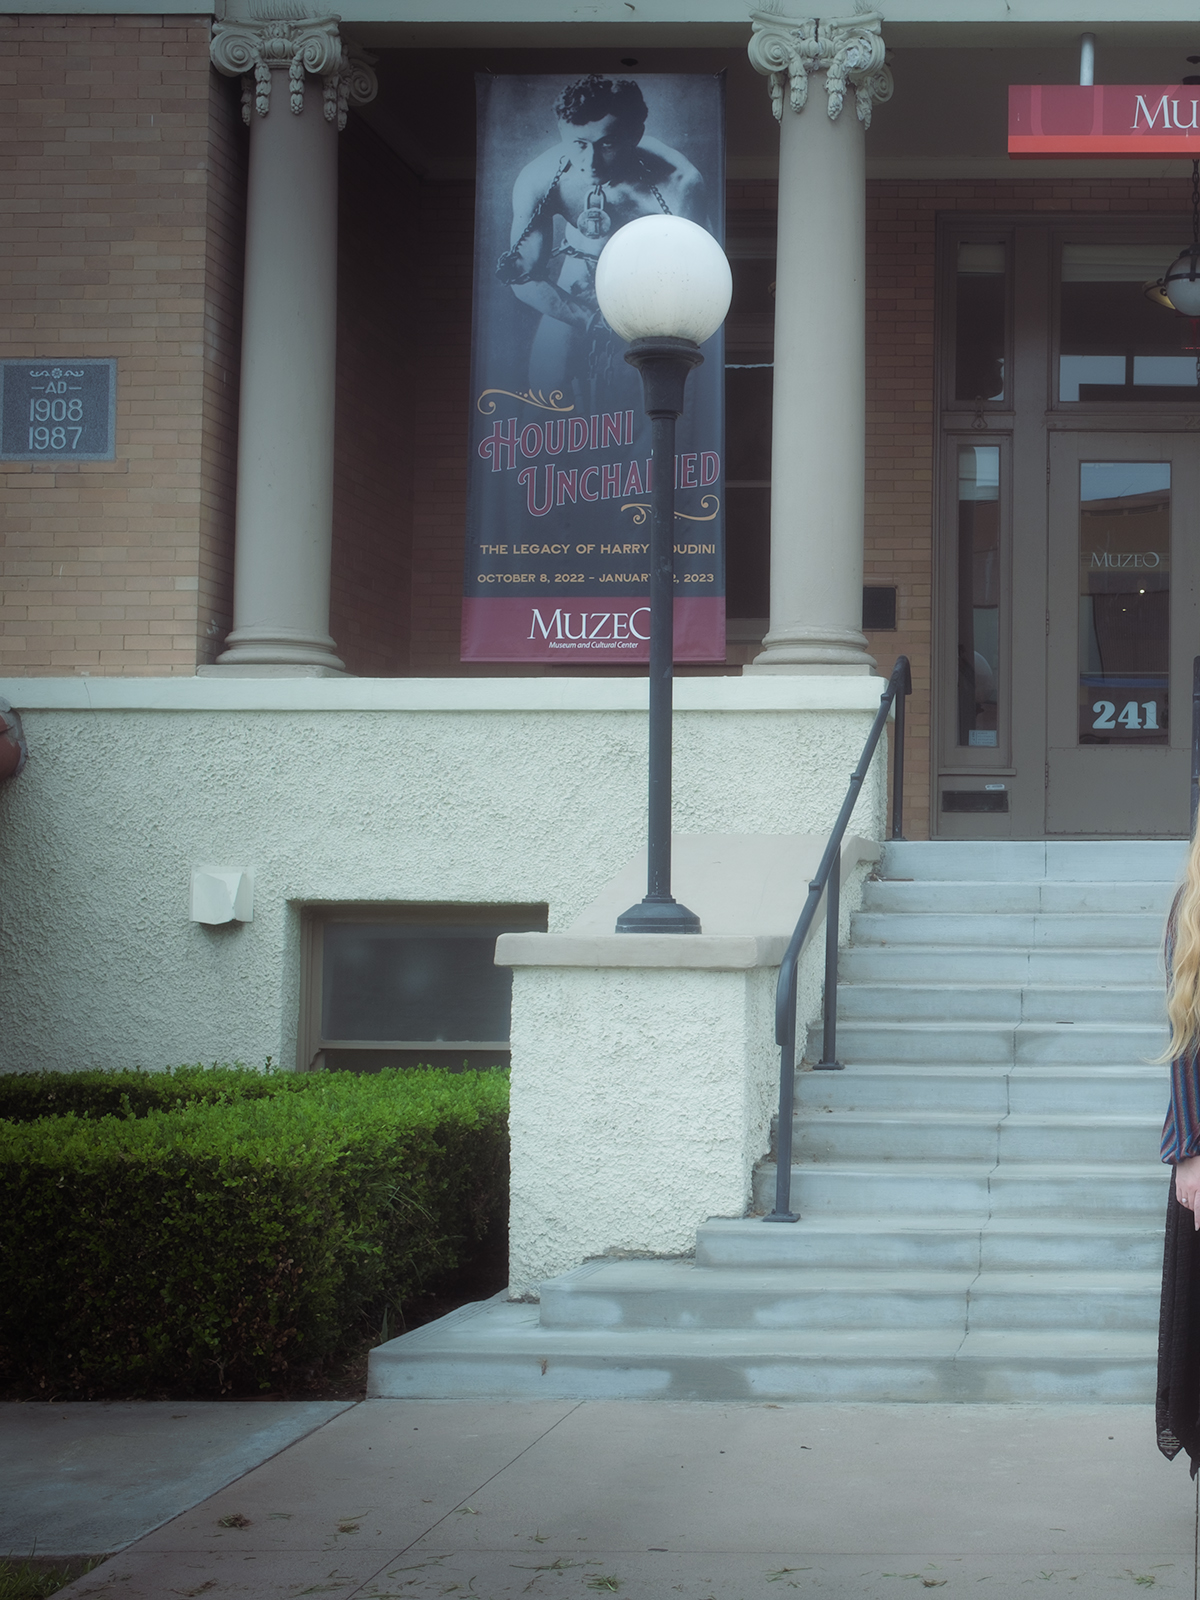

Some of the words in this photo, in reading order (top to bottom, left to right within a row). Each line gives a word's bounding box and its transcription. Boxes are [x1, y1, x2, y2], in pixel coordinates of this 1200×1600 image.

[45, 381, 67, 394] AD
[29, 398, 84, 422] 1908
[28, 426, 83, 450] 1987
[478, 409, 634, 472] HOUDINI
[517, 450, 721, 517] UNCHAIED
[480, 544, 508, 555] THE
[513, 543, 570, 555] LEGACY
[575, 543, 596, 554] OF
[600, 543, 650, 554] HARRY
[673, 543, 716, 555] UDINI
[1090, 551, 1160, 568] MUZEO
[477, 573, 536, 583] OCTOBER
[539, 573, 551, 585] 8,
[554, 573, 585, 583] 2022
[599, 573, 652, 583] JANUAR
[683, 573, 715, 583] 2023
[548, 641, 577, 649] Museum
[577, 641, 590, 649] and
[591, 641, 617, 649] Cultural
[617, 641, 639, 649] Center
[1092, 700, 1160, 730] 241
